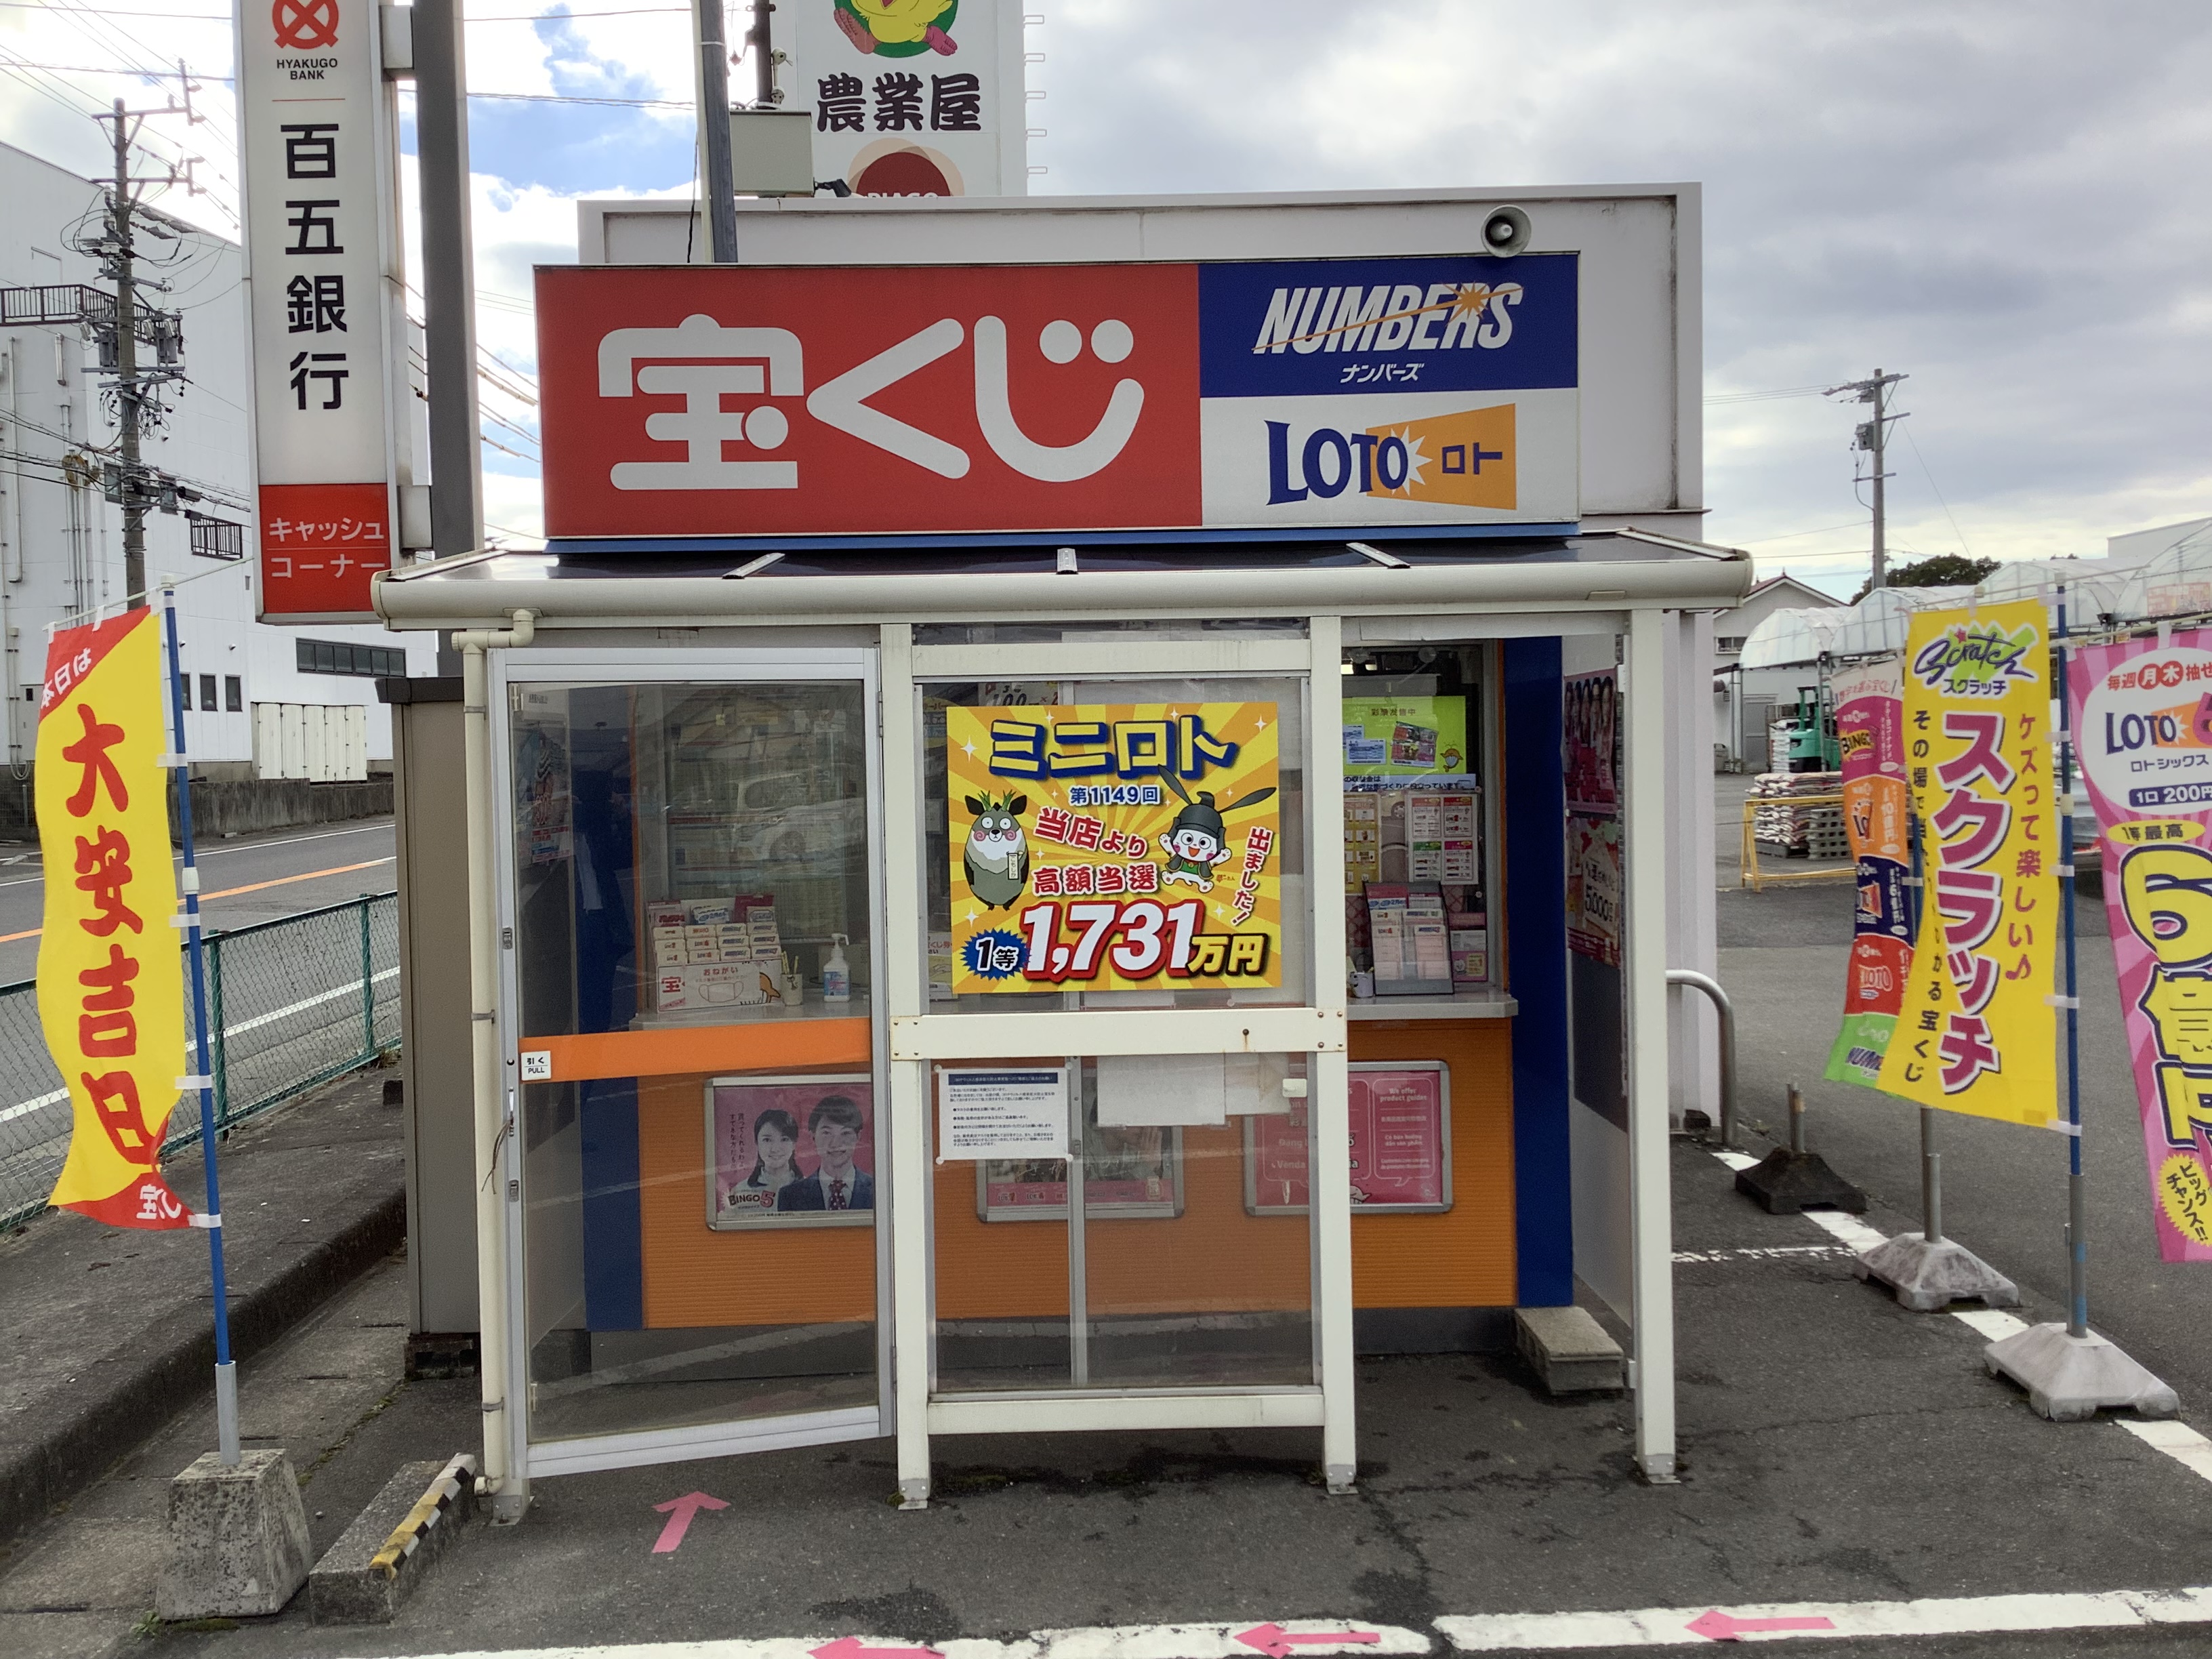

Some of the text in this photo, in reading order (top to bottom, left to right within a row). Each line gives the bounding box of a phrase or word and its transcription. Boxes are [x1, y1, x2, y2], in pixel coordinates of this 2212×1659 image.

[276, 58, 338, 69] HYAKUGO
[289, 70, 325, 81] BANK
[817, 72, 981, 133] 農業屋
[280, 123, 349, 411] 百五銀行
[1252, 281, 1524, 354] NUMBERS
[1340, 363, 1425, 384] ナンバーズ
[597, 313, 1145, 491] 宝くじ
[1263, 419, 1409, 506] LOTO
[269, 517, 385, 543] キャッシュ
[270, 553, 386, 579] コーナー
[1914, 631, 2036, 686] Scratch
[1943, 678, 2007, 695] スクラッチ
[989, 714, 1239, 781] ミニロト
[2105, 712, 2177, 756] LOTO
[2130, 754, 2209, 773] ロトシックス
[1069, 785, 1160, 806] 第1149回
[2135, 785, 2212, 804] 1口 200円
[1033, 807, 1149, 860] 当店より
[1031, 861, 1158, 897] 高額当選
[1231, 825, 1274, 926] 出ました!
[1933, 710, 2017, 1095] スクラッチ
[62, 703, 161, 1166] 大安吉日
[703, 966, 739, 977] おねがい
[975, 935, 1019, 972] 1等
[527, 1057, 545, 1065] 引く
